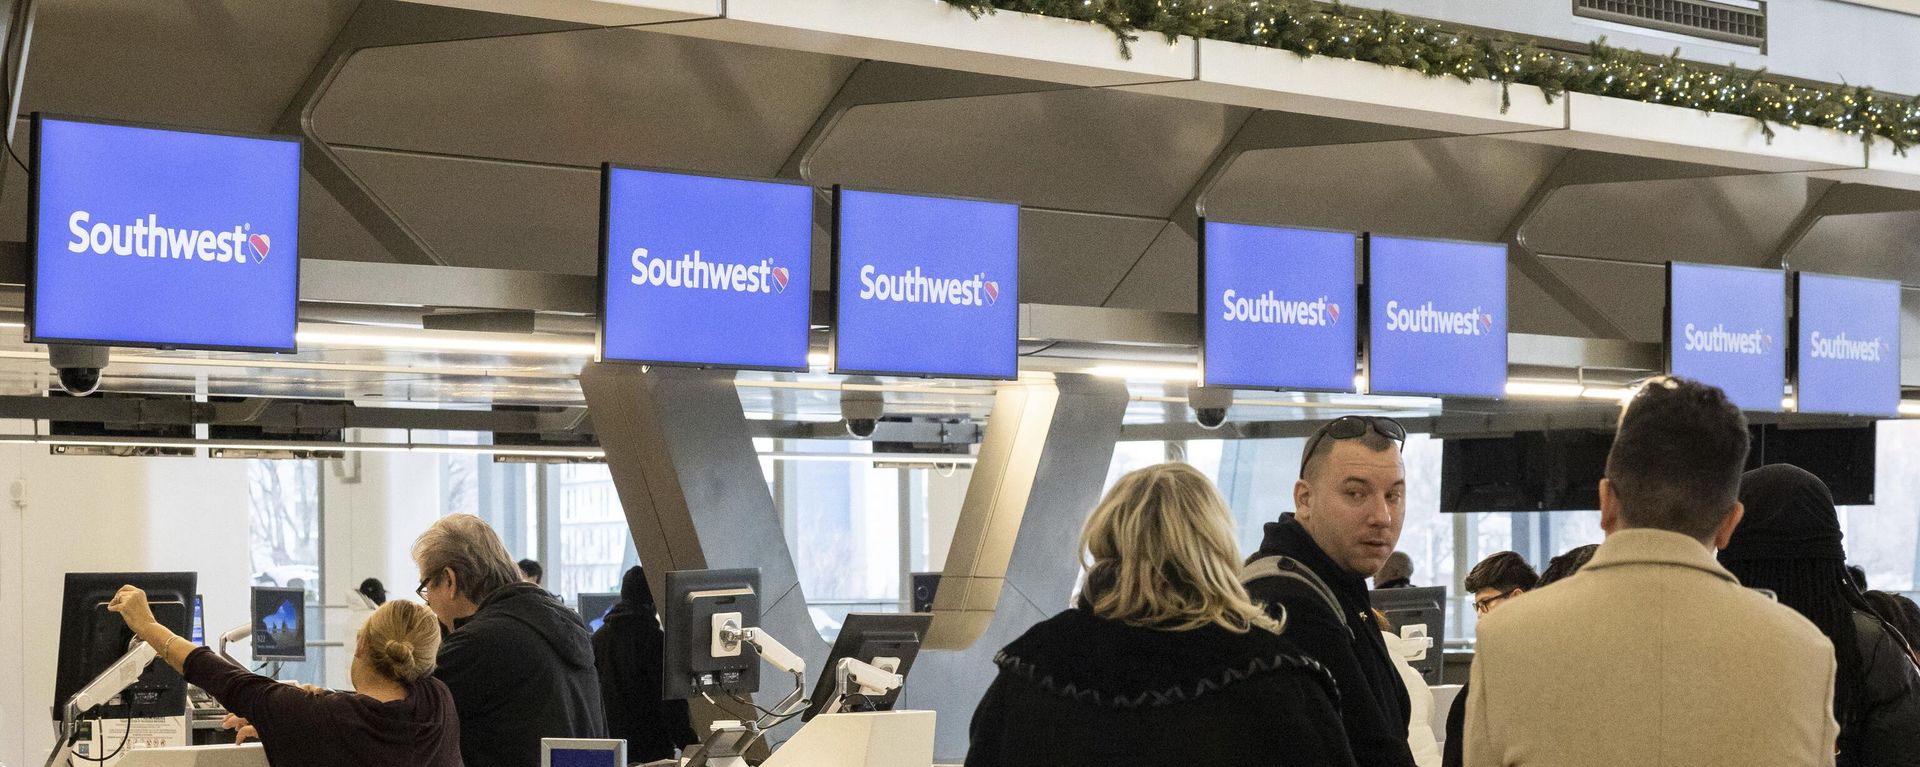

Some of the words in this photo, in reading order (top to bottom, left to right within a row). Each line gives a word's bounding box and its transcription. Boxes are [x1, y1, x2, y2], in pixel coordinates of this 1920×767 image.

[69, 211, 246, 263] Southwest
[632, 248, 770, 293] Southwest
[861, 265, 982, 306] Southwest
[1224, 289, 1325, 326] Southwest
[1387, 301, 1479, 335] Southwest
[1686, 323, 1761, 354] Southwest
[1812, 332, 1880, 361] Southwest
